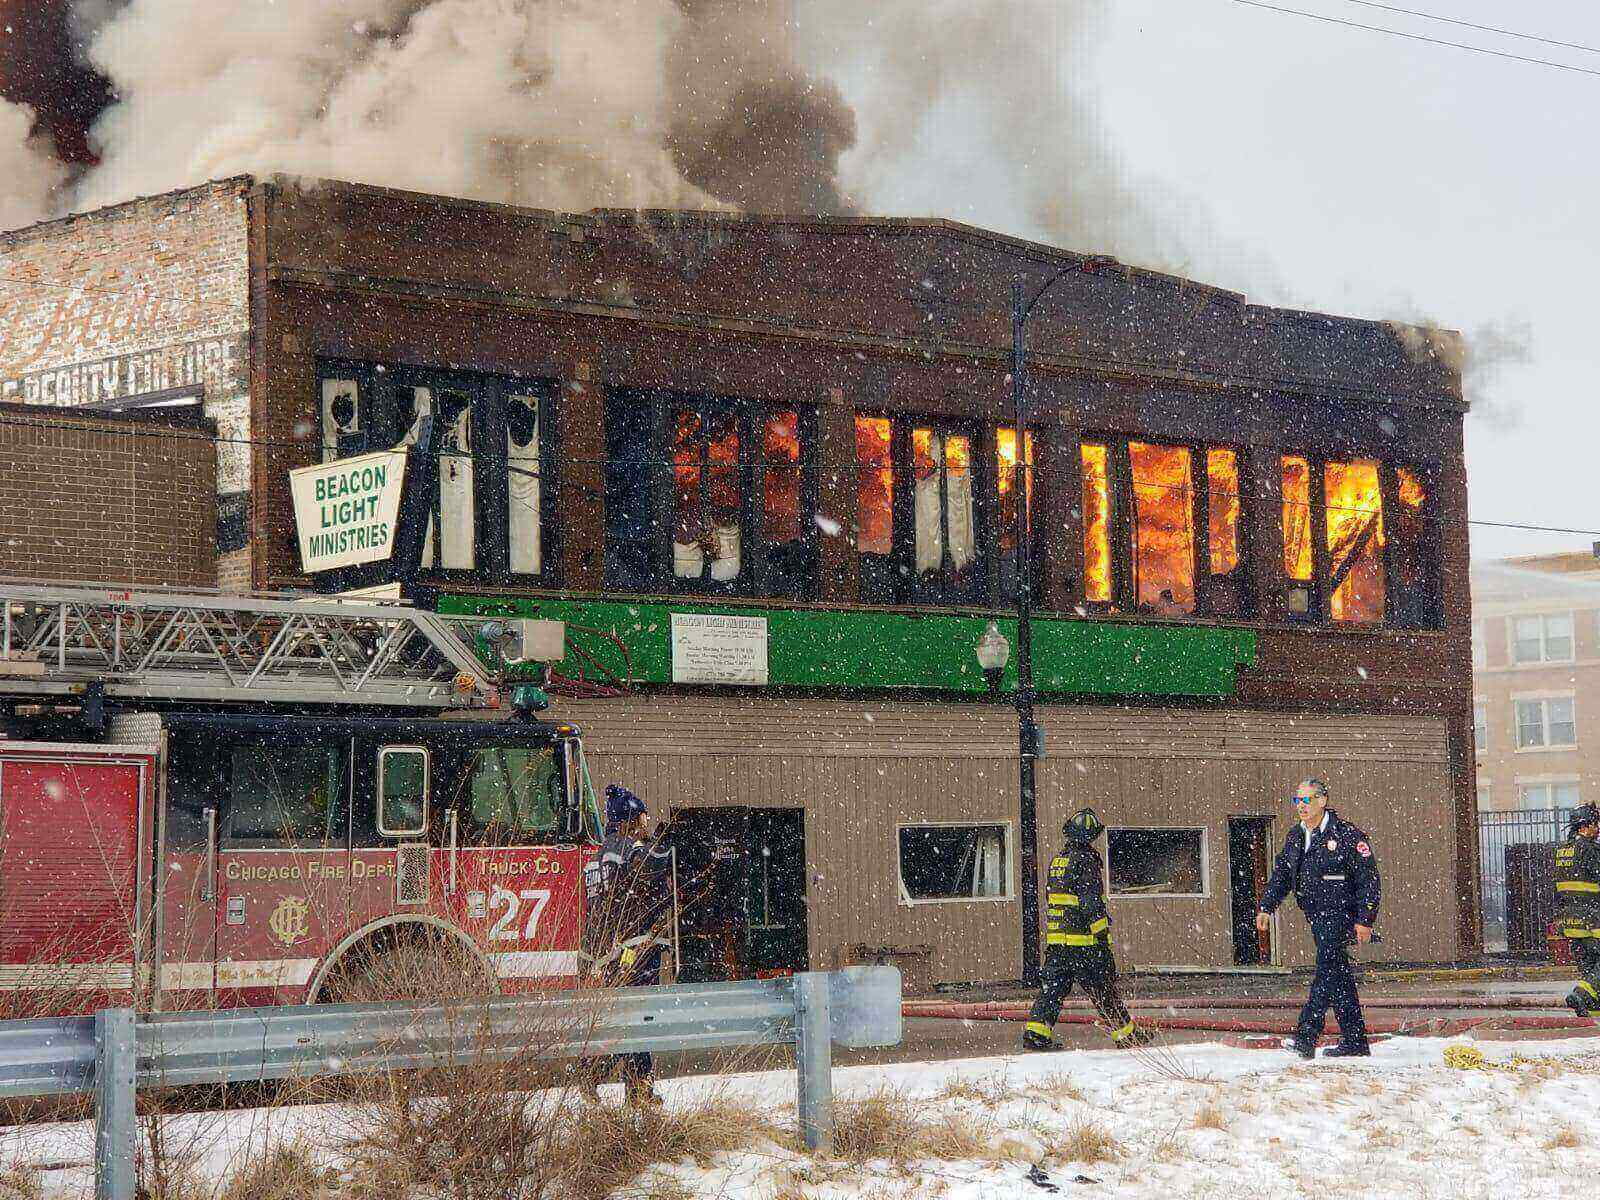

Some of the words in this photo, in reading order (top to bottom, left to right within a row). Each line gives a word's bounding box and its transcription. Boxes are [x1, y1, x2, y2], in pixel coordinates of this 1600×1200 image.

[315, 465, 387, 501] BEACON
[321, 495, 379, 528] LIGHT
[309, 522, 388, 558] MINISTRIES
[488, 888, 551, 940] 27
